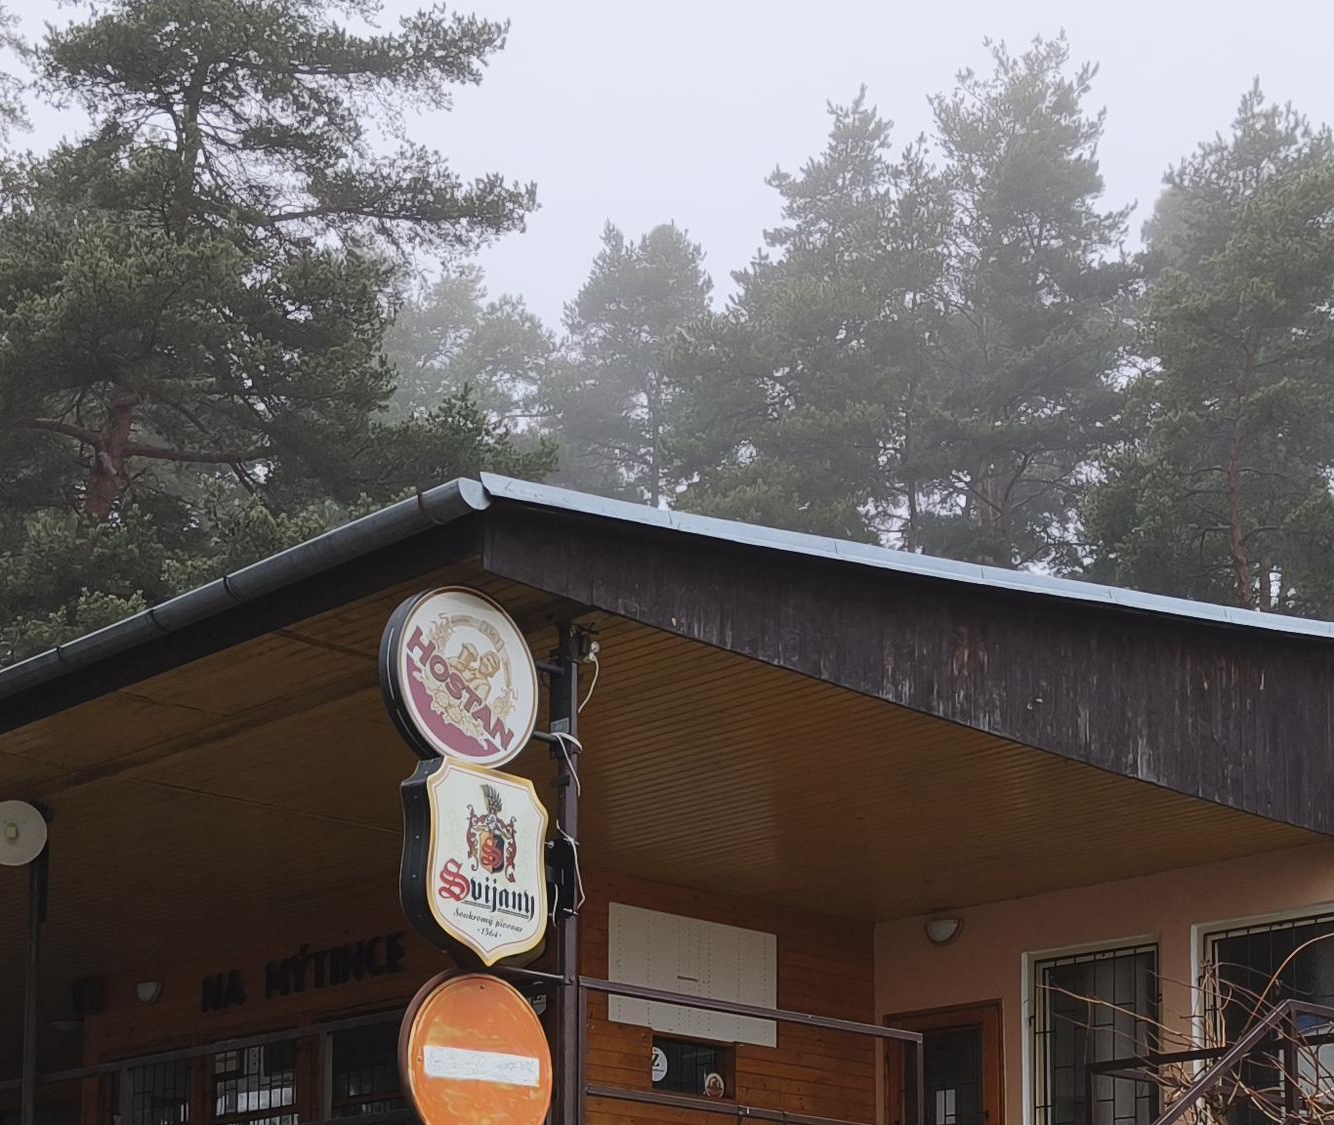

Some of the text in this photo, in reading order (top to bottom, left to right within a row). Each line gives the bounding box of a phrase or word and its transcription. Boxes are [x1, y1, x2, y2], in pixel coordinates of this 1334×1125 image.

[407, 626, 514, 751] HOSTAN
[438, 858, 535, 921] Svijany
[201, 931, 405, 1013] NA MÝTINCE
